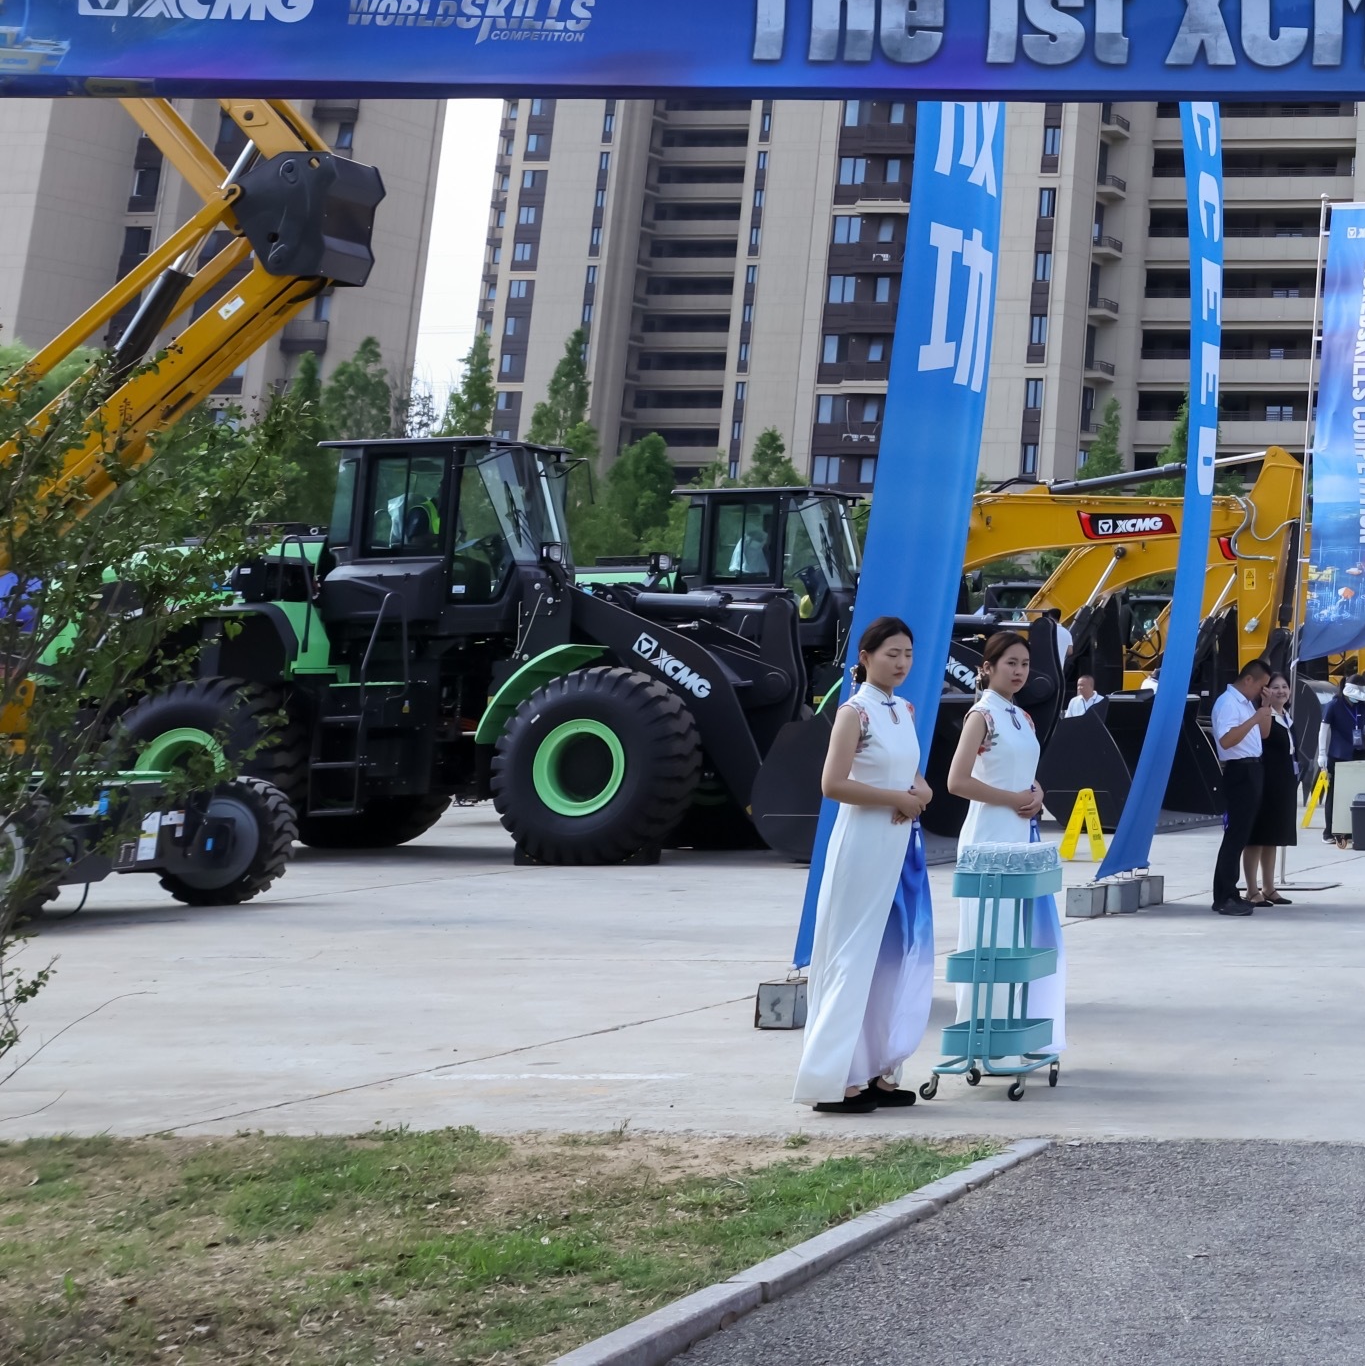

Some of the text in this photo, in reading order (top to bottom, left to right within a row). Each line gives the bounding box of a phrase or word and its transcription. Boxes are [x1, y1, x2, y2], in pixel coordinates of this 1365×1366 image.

[490, 30, 586, 43] COMPETITION
[1190, 102, 1222, 496] CCEED
[1115, 516, 1164, 534] XCMG
[653, 645, 712, 698] XCMG
[946, 655, 977, 691] XCM
